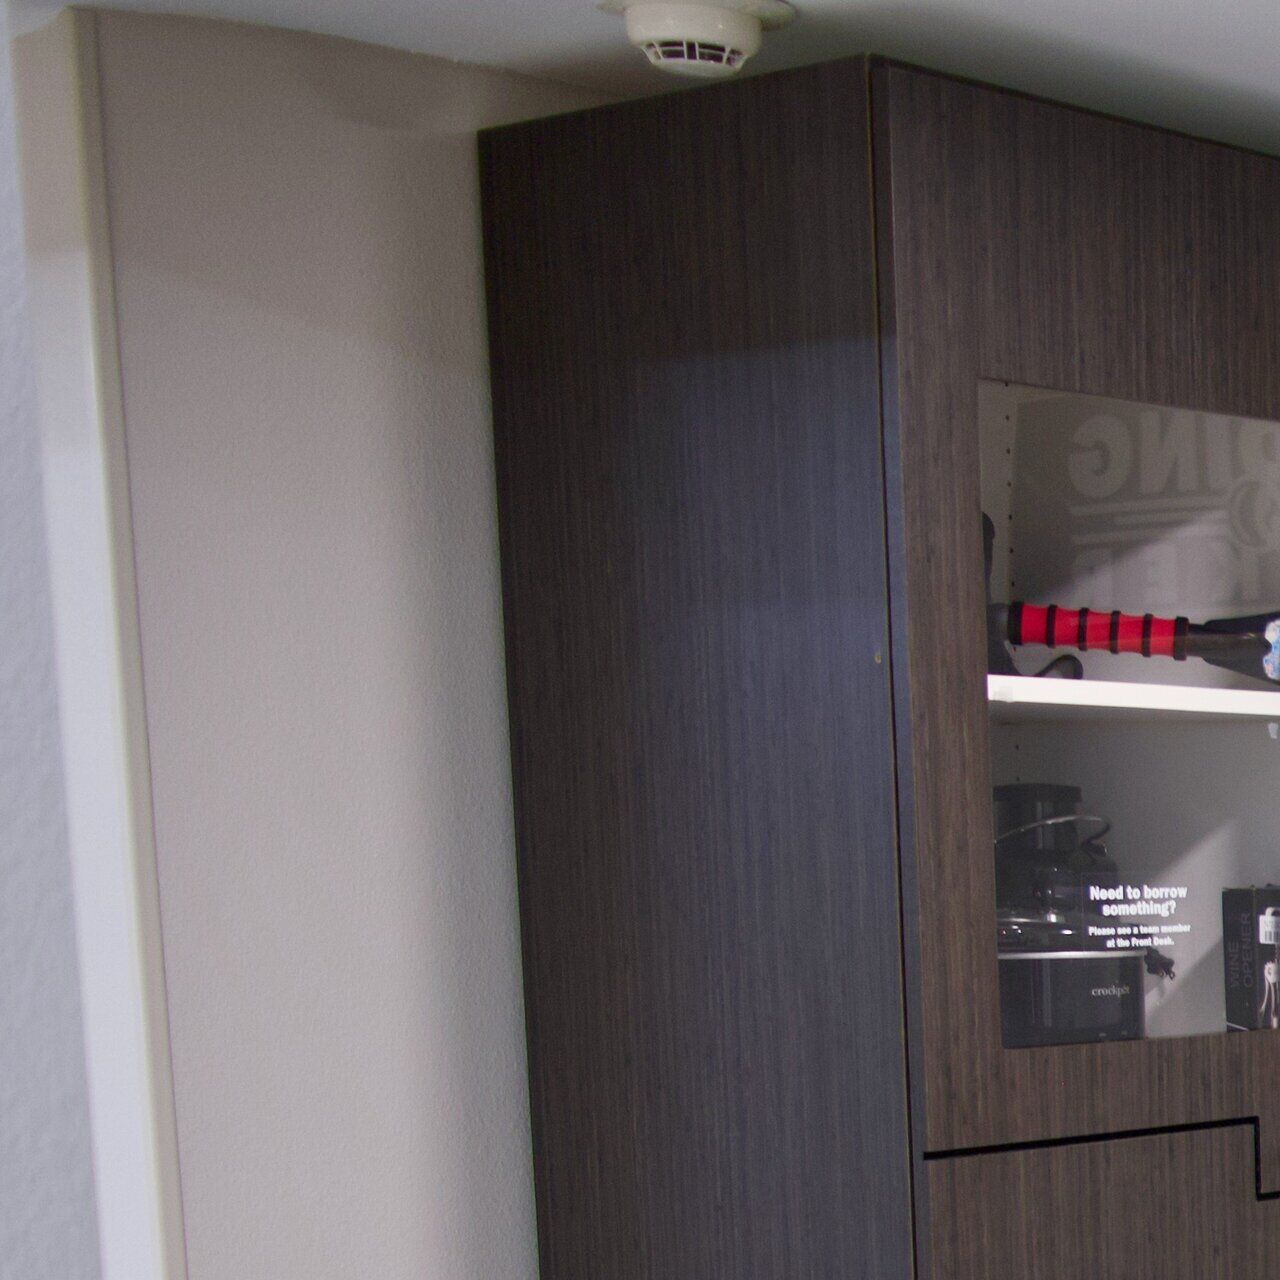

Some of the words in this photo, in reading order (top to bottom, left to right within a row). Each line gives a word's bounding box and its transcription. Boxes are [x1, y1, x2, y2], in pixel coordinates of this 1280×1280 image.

[1089, 885, 1124, 900] Need
[1126, 884, 1141, 899] to
[1143, 884, 1188, 899] borrow
[1102, 900, 1177, 918] something?
[1088, 925, 1116, 936] Please
[1117, 926, 1132, 935] see
[1133, 926, 1139, 934] a
[1140, 925, 1160, 934] team
[1161, 923, 1191, 933] member
[1106, 938, 1116, 948] at
[1116, 938, 1130, 947] the
[1131, 937, 1152, 947] Front
